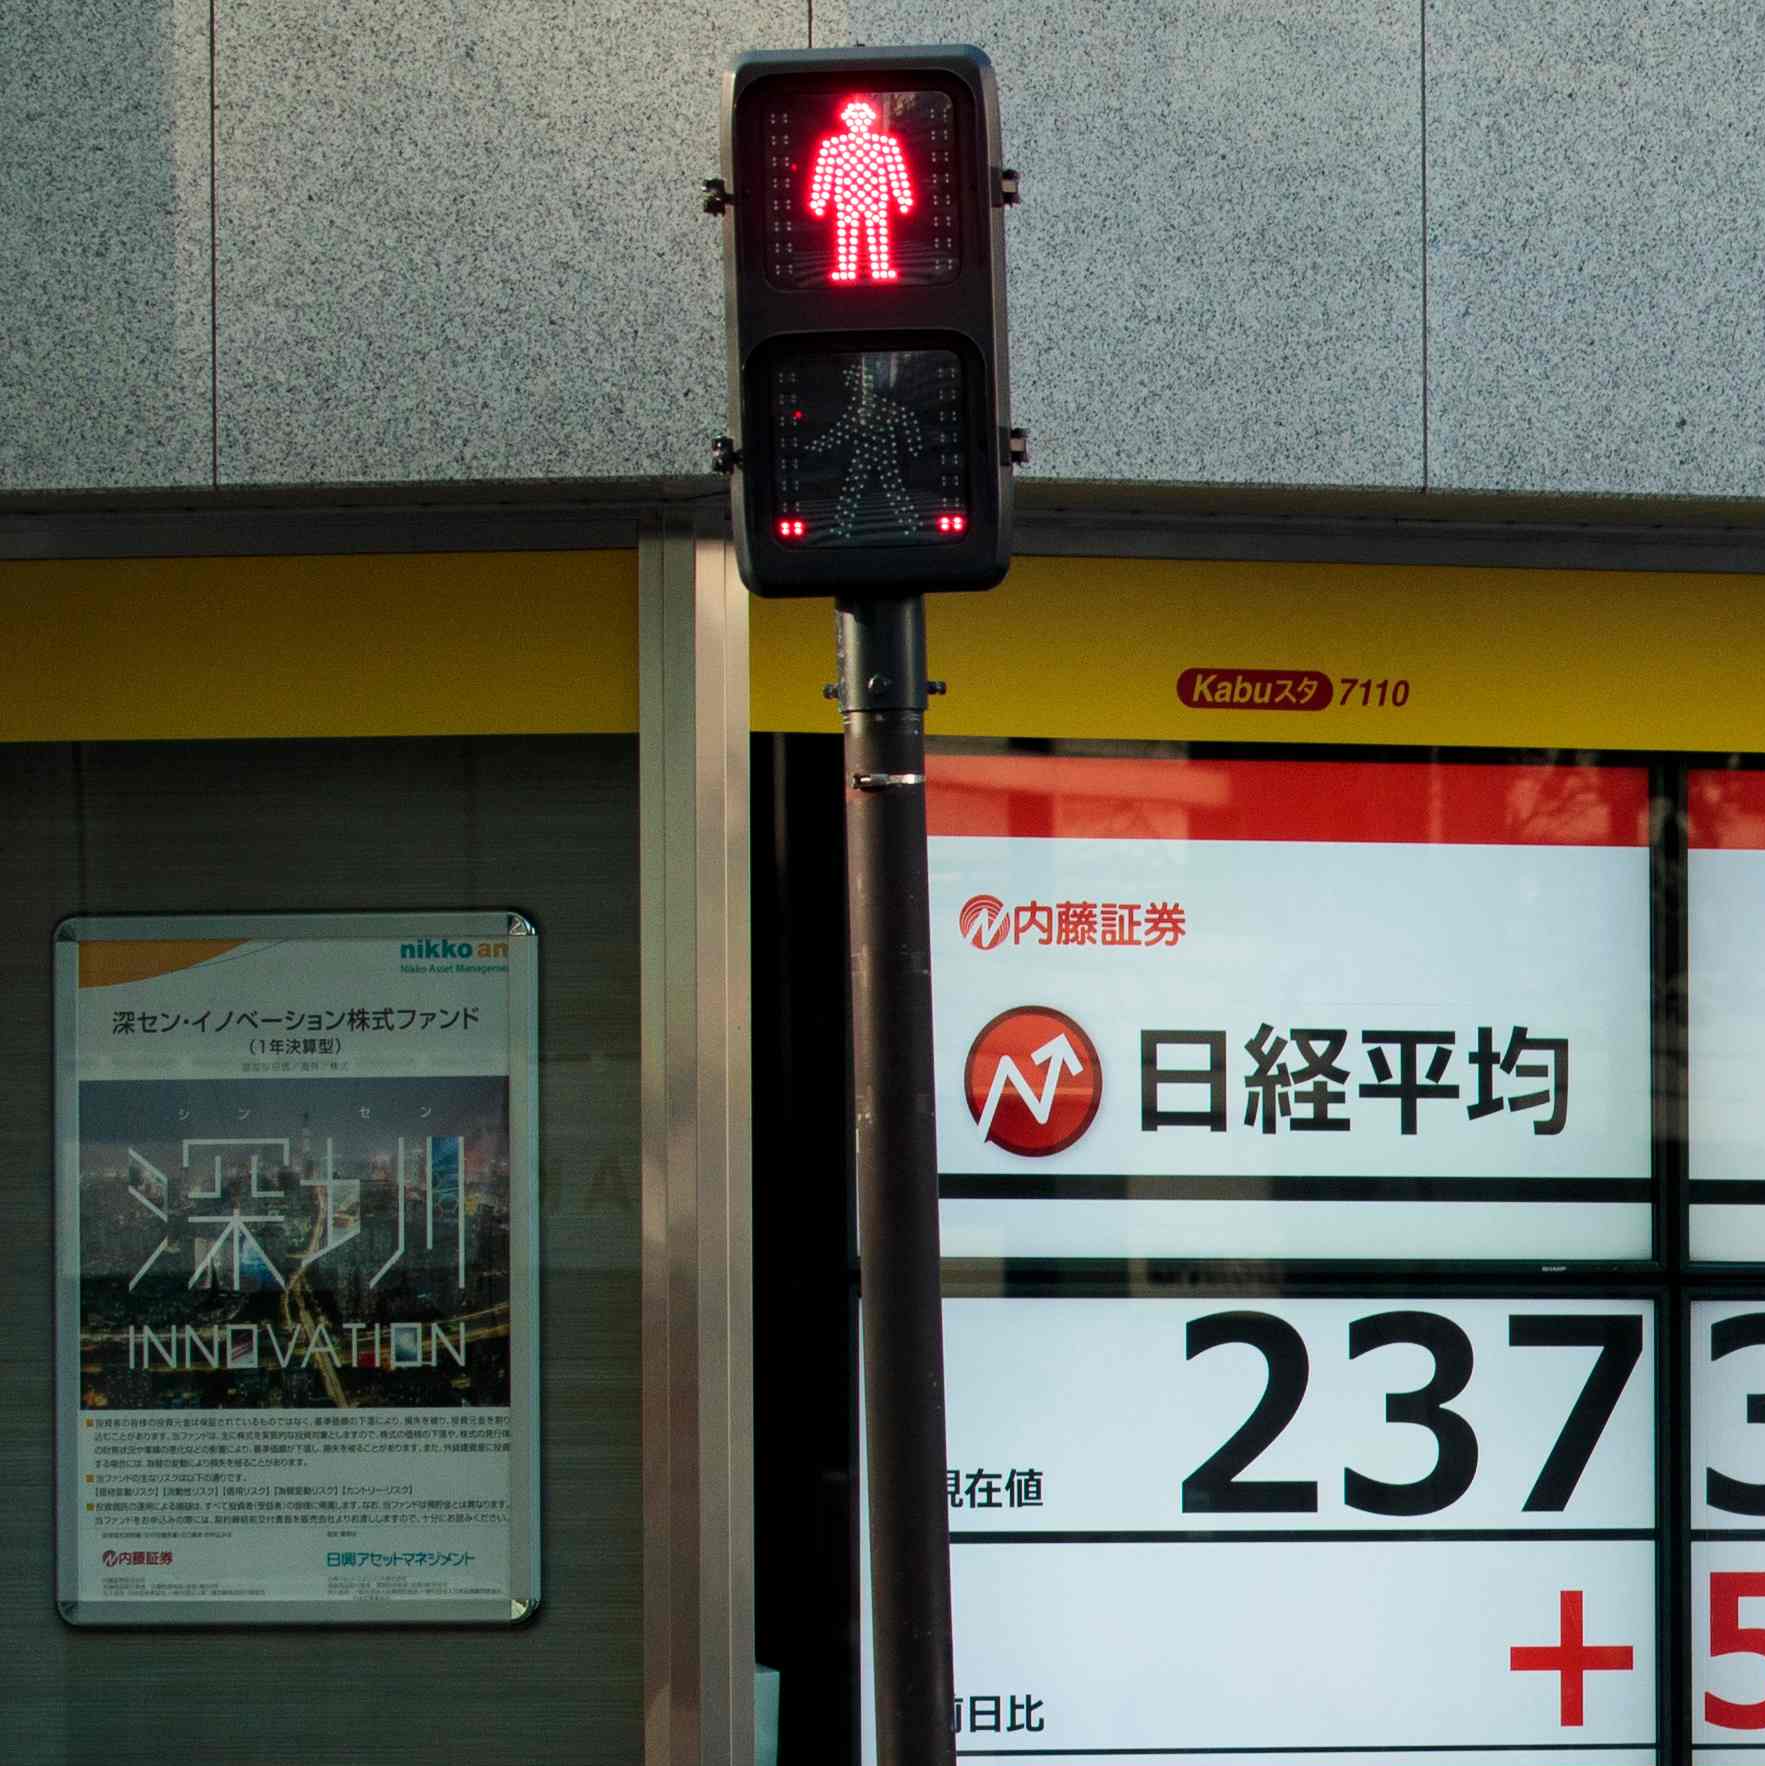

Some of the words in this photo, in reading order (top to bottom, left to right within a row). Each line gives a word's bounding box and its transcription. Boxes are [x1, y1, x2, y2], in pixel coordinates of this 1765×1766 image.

[1192, 673, 1319, 706] Kabuスタ
[1338, 679, 1411, 708] 7110
[1012, 900, 1187, 949] 内藤証券
[400, 937, 473, 959] nikko
[112, 1007, 480, 1035] 深セン・イノベーション株式ファンド
[1140, 1022, 1570, 1137] 日経平均
[128, 1321, 466, 1369] INNOVATION
[948, 1693, 1046, 1735] 日比
